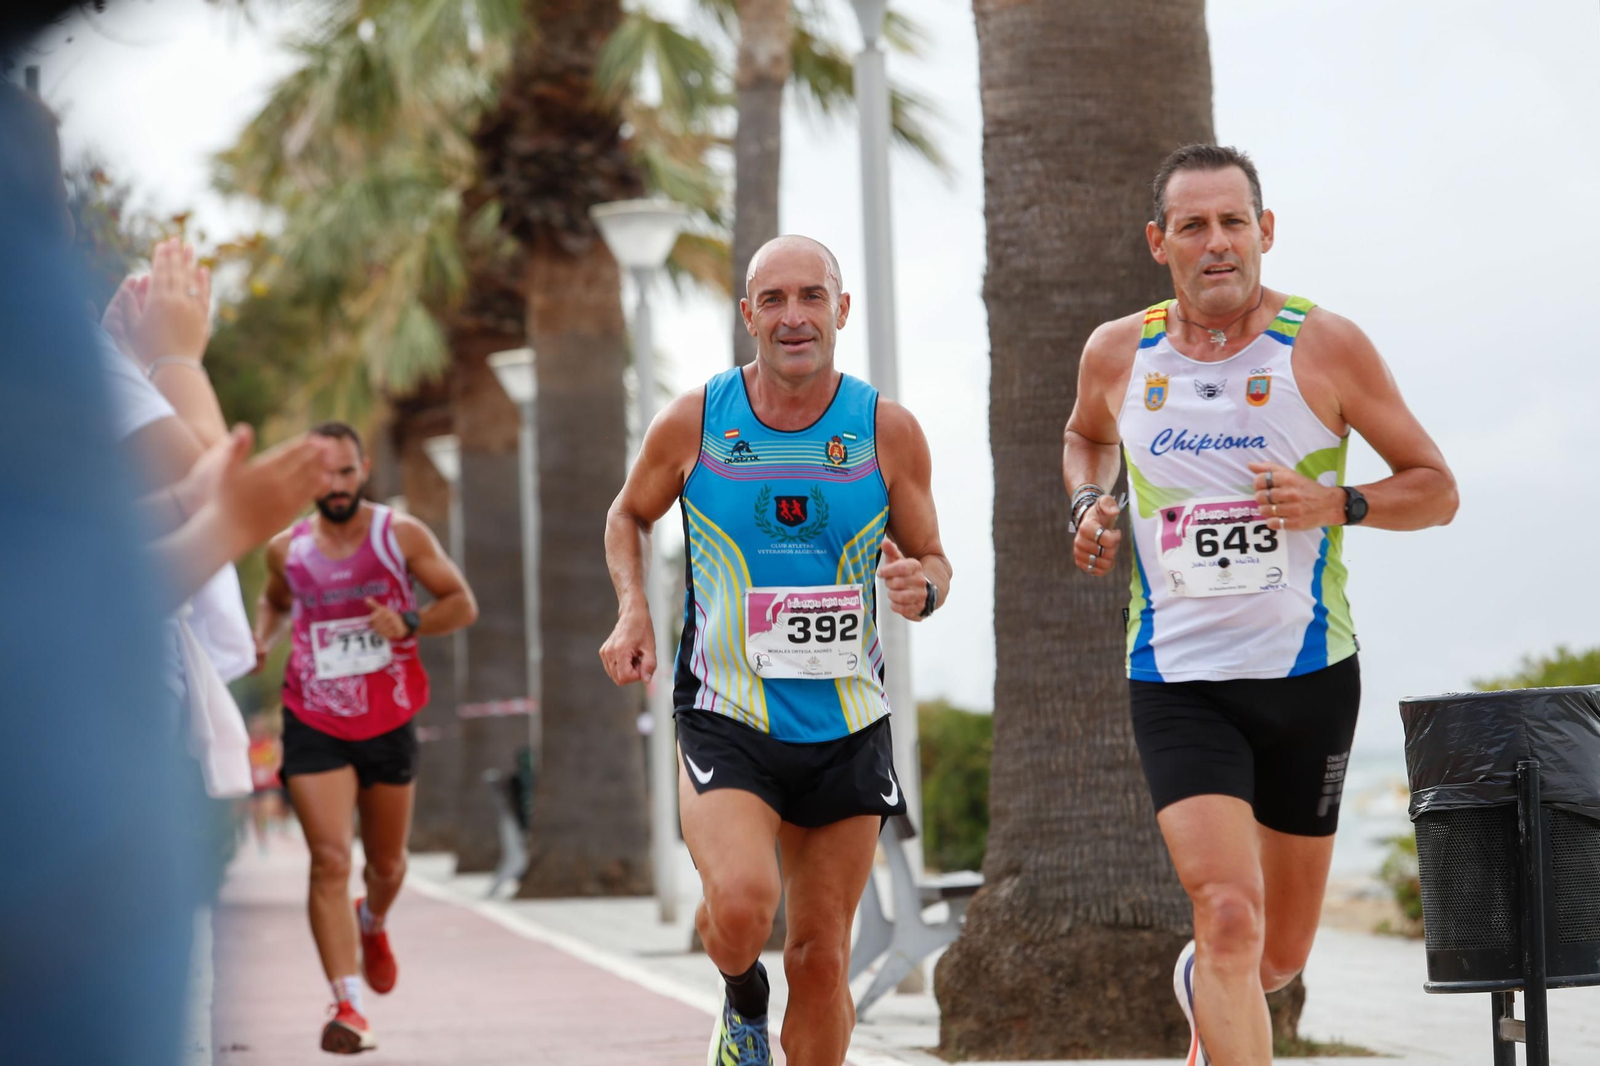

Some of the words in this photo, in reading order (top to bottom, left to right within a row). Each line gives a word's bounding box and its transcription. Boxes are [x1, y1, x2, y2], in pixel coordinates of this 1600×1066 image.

[1149, 428, 1269, 456] Chipiona
[1195, 524, 1279, 558] 643
[787, 613, 859, 644] 392
